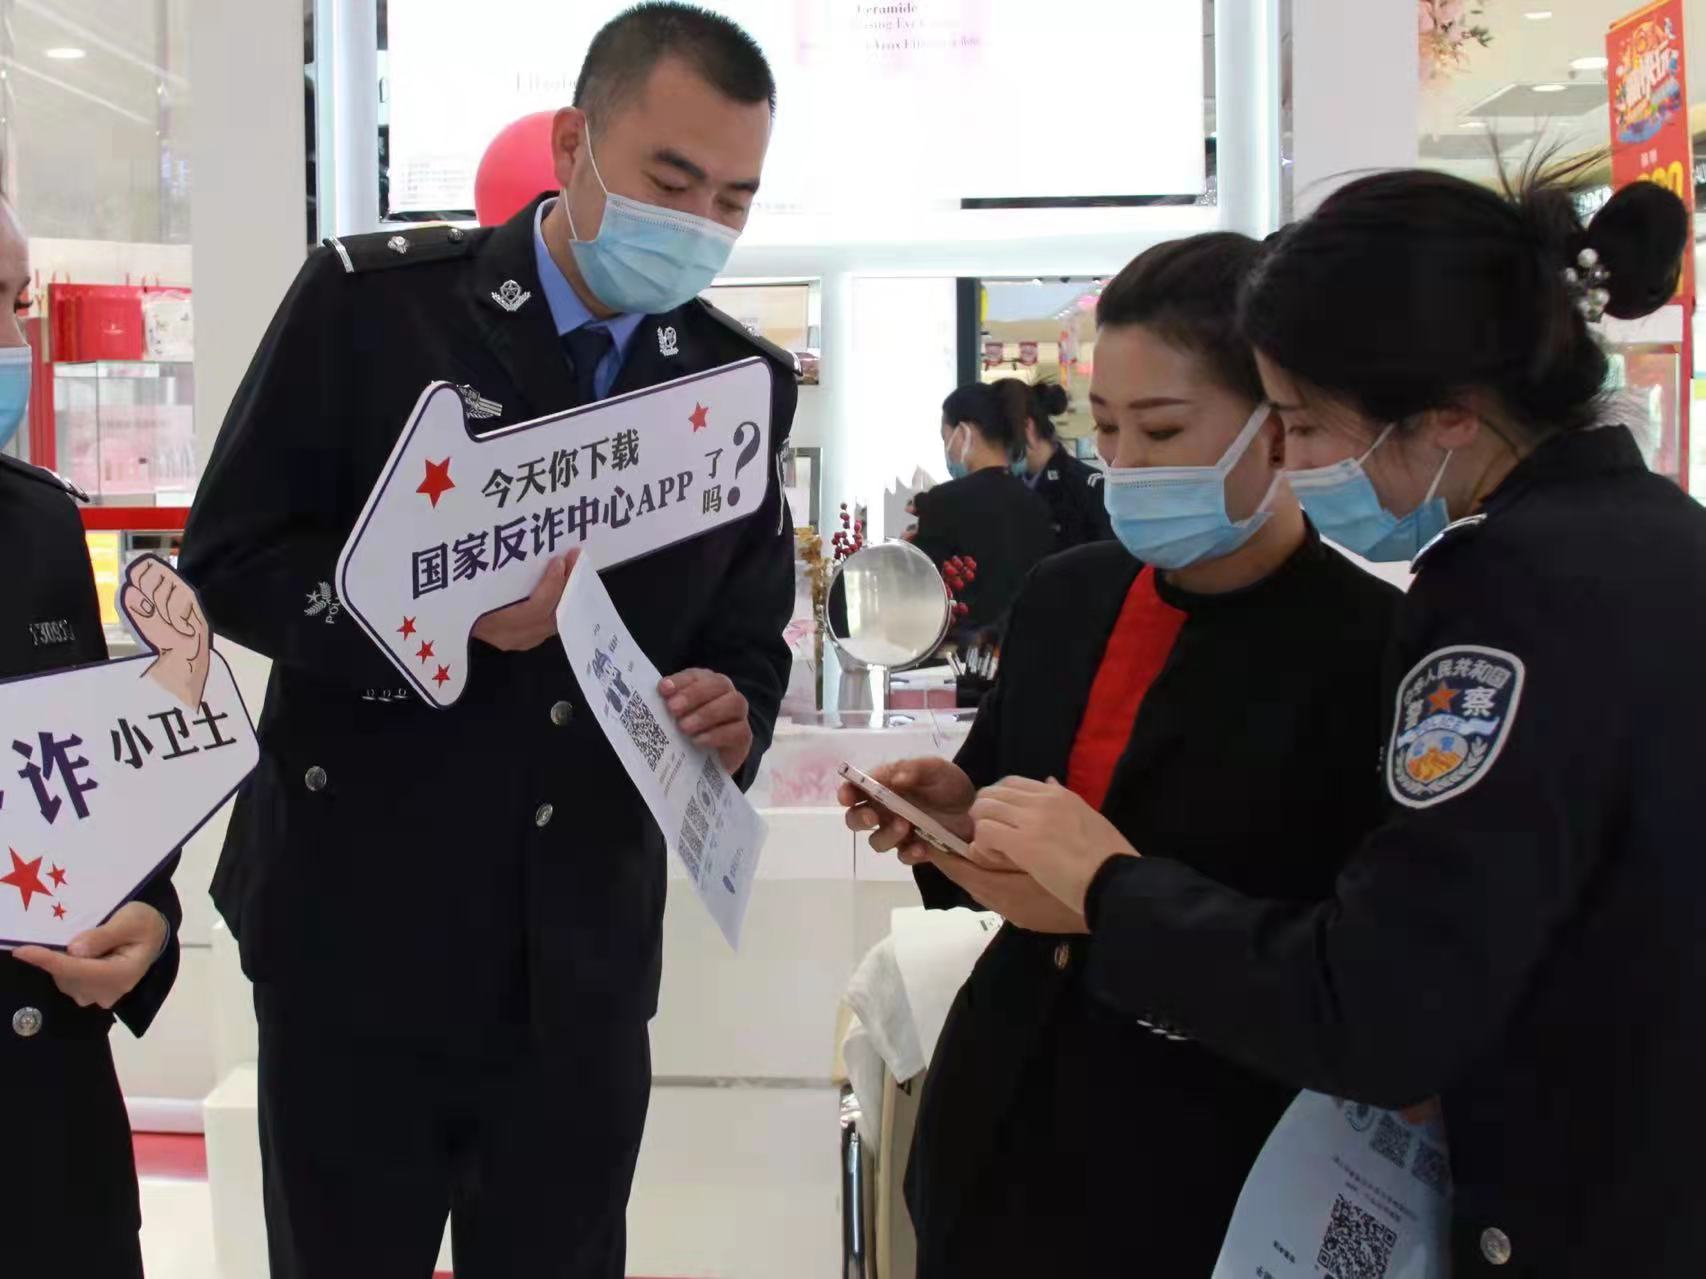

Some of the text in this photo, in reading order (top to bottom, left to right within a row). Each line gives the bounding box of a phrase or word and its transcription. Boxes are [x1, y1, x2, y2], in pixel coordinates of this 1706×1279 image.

[481, 428, 640, 509] 今天你下载
[411, 470, 694, 601] 国家反诈中心APP
[0, 701, 237, 825] 诈 小卫士
